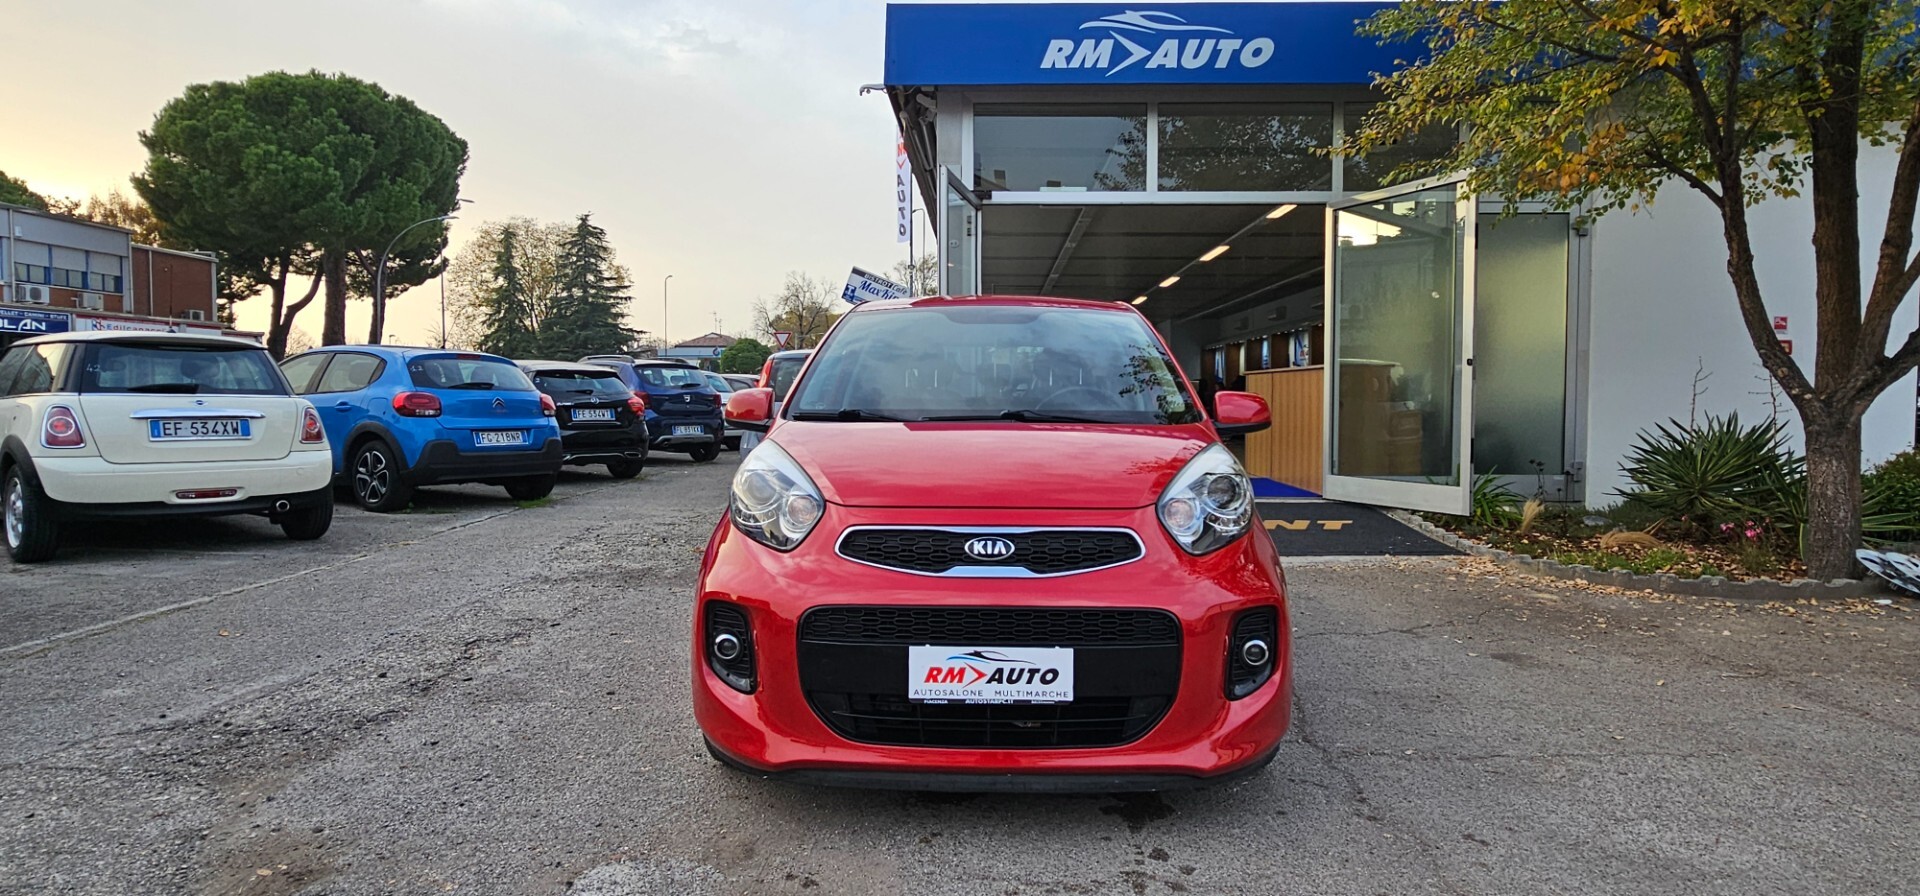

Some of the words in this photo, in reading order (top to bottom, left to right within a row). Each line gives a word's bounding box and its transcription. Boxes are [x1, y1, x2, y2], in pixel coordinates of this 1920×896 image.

[1040, 38, 1114, 69] RM
[1144, 37, 1275, 70] AUTO
[163, 422, 182, 436] EF
[190, 421, 240, 435] 534XW
[481, 431, 492, 440] FG
[973, 540, 1007, 555] KIA
[924, 666, 966, 684] RM
[985, 667, 1060, 686] AUTO
[913, 689, 983, 697] AUTOSALONE
[994, 690, 1069, 698] MULTIMARCHE
